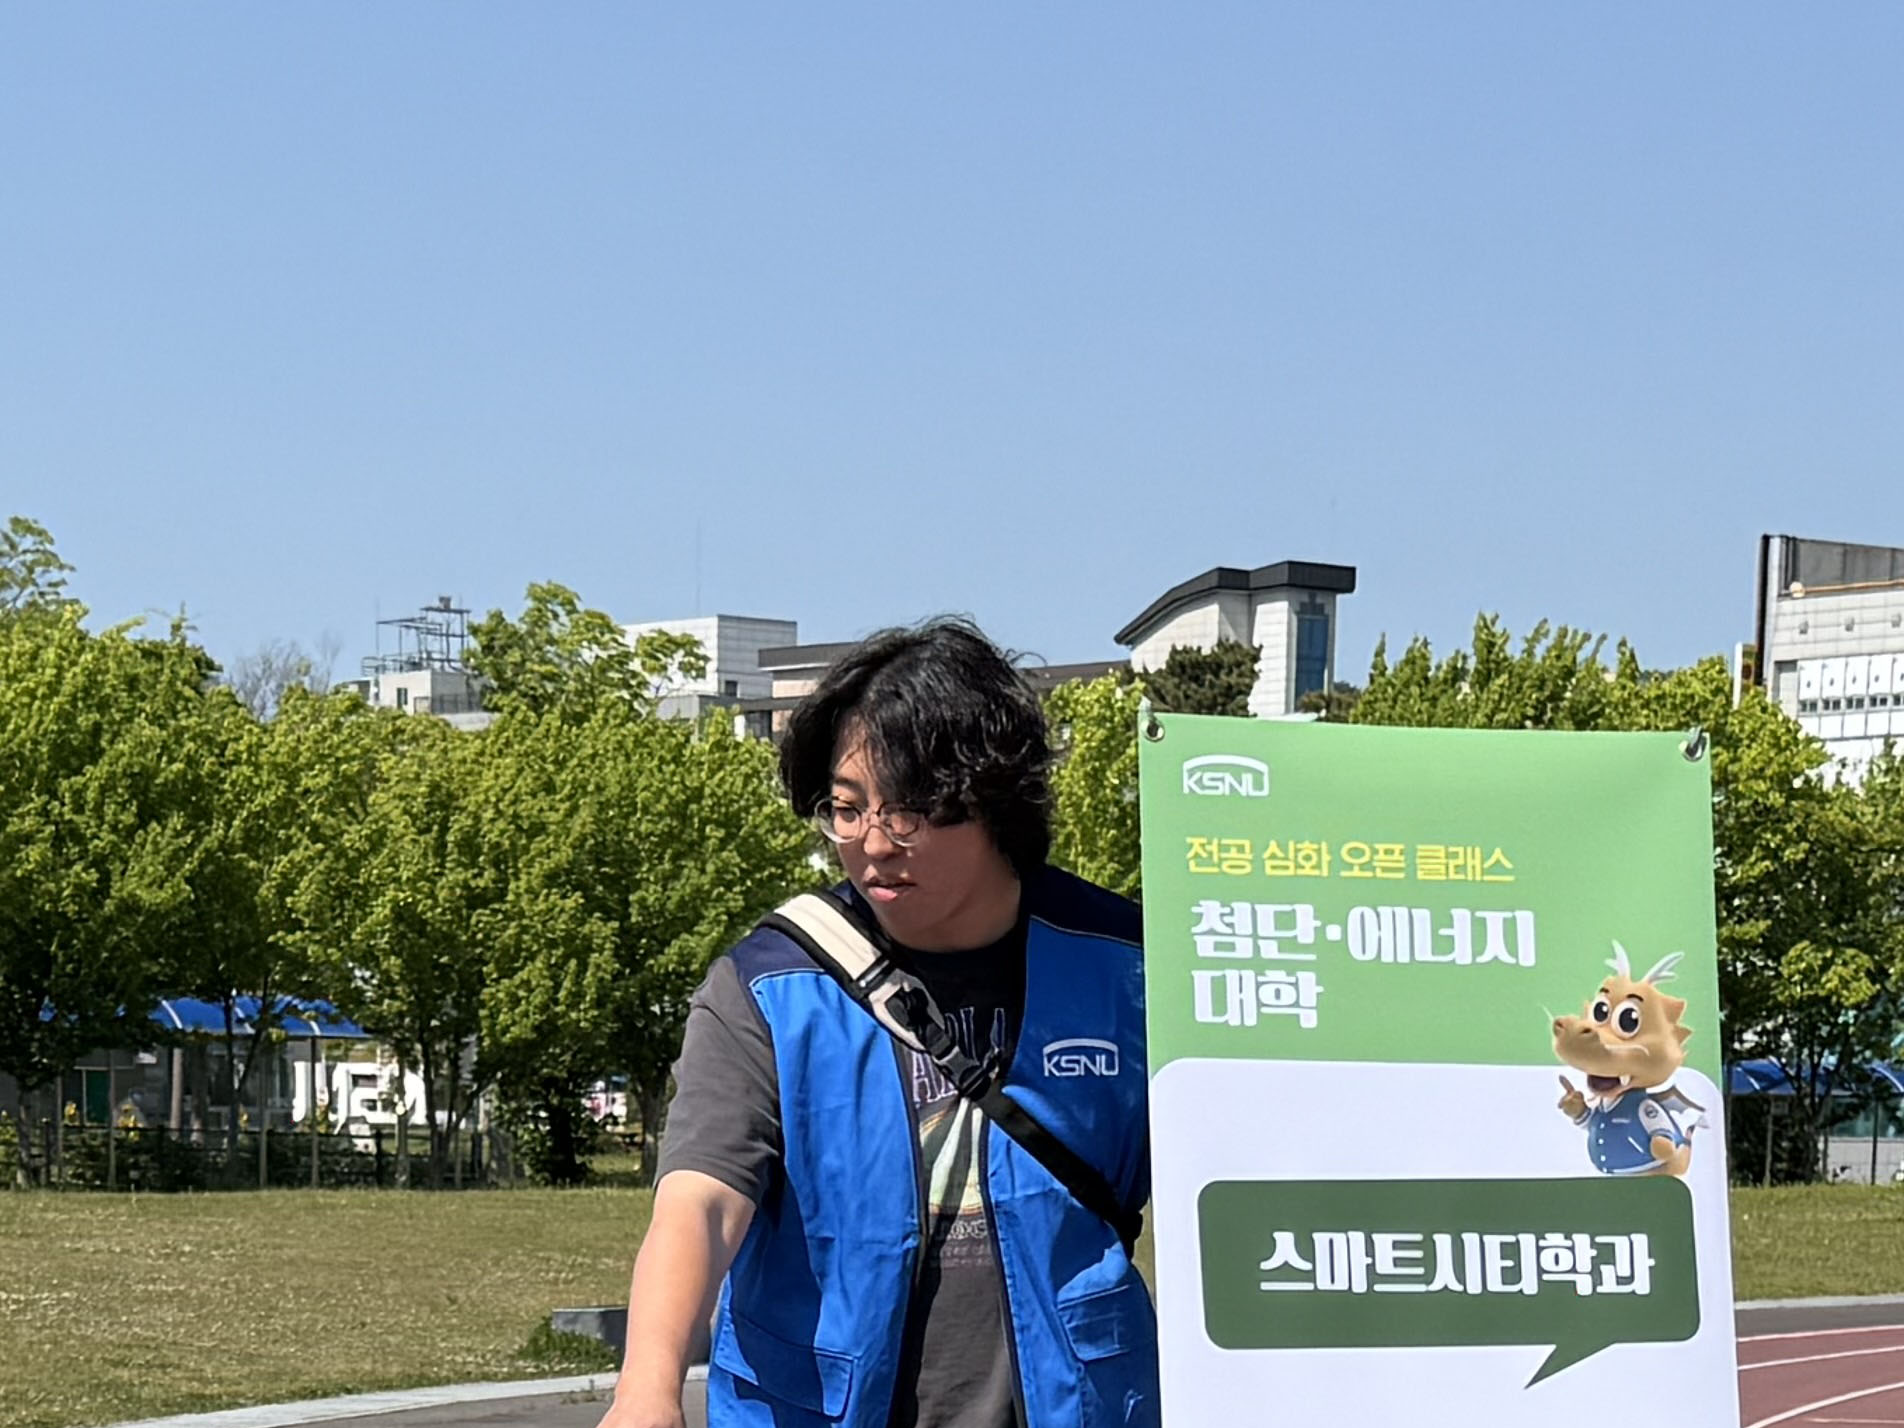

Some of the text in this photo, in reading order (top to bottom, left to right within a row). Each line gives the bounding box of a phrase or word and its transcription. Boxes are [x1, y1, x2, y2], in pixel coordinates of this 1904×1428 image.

[1182, 764, 1269, 797] KSNU
[1186, 836, 1516, 884] 전공 심화 오픈 클래스
[1190, 901, 1537, 967] 첨단·에너지
[1191, 969, 1324, 1028] 대학
[1043, 1047, 1119, 1077] KSNU
[1259, 1230, 1656, 1296] 스마트시티학과
